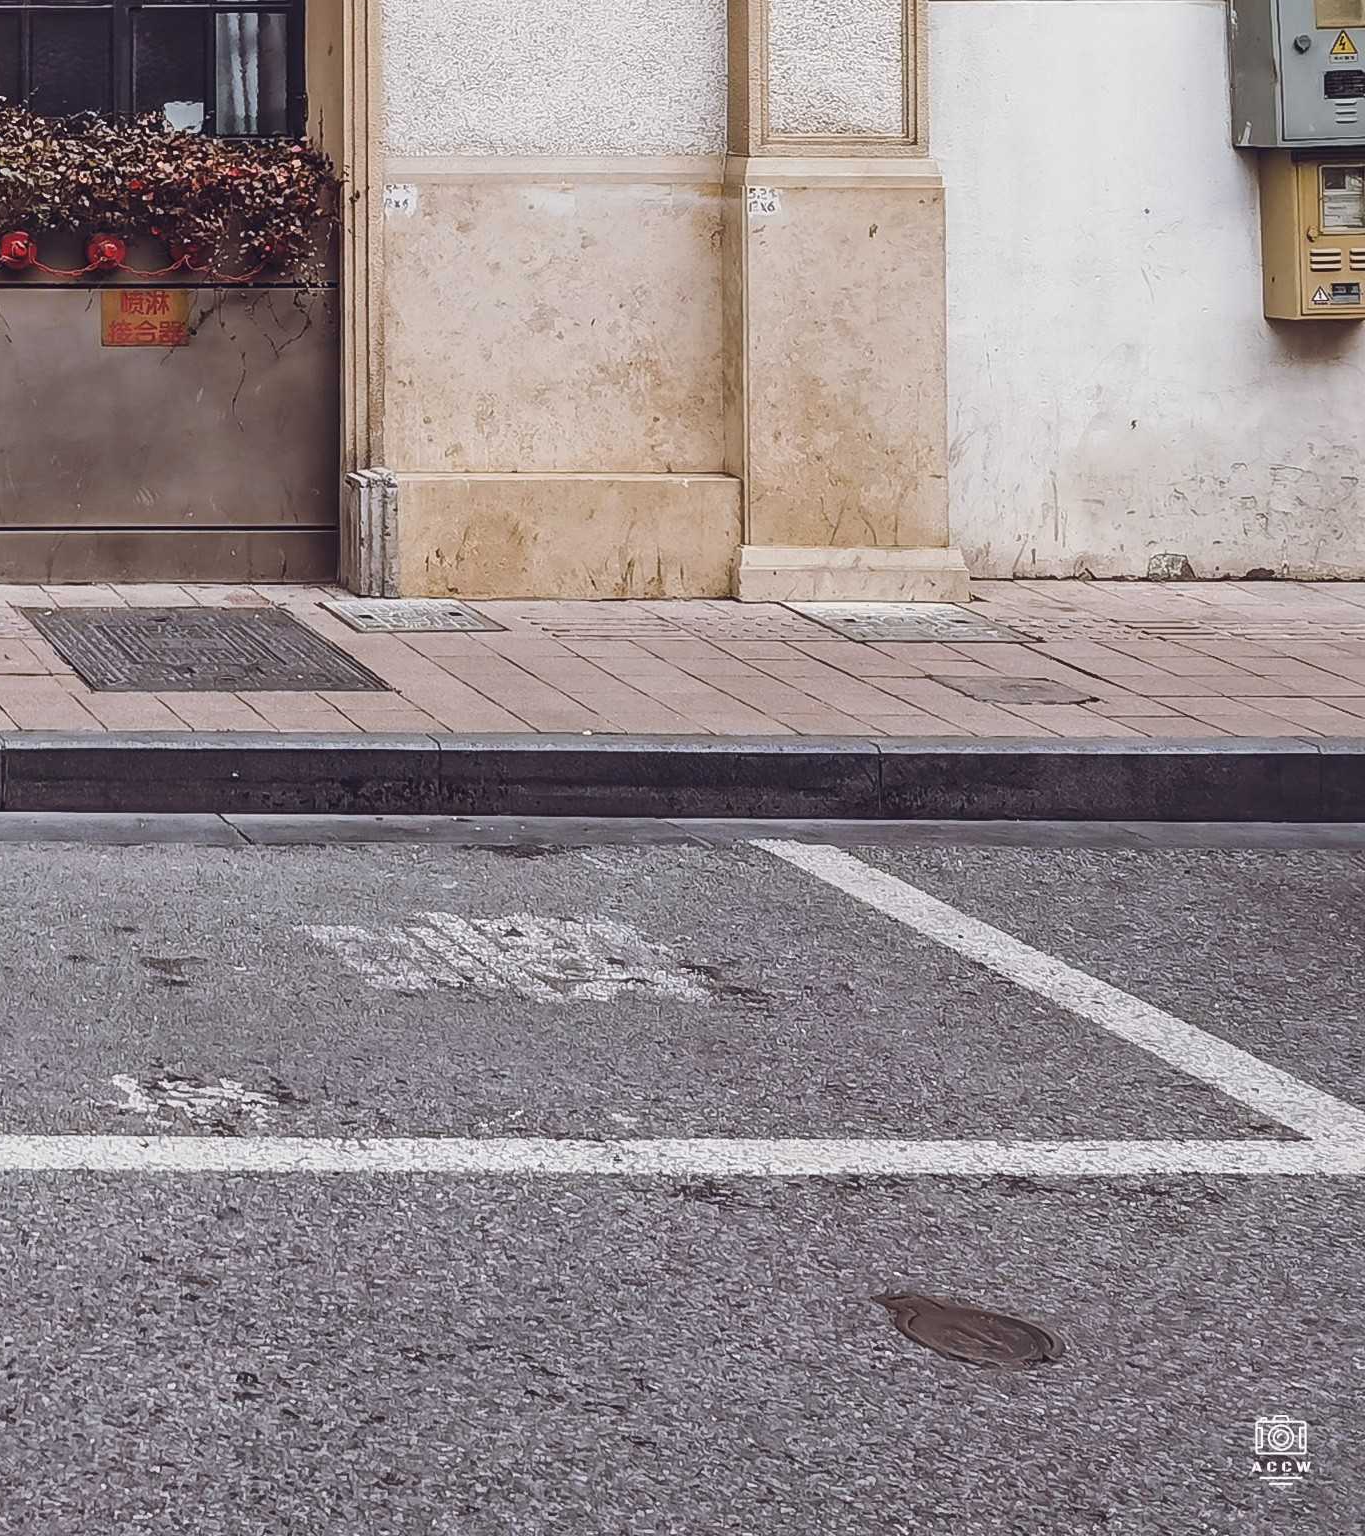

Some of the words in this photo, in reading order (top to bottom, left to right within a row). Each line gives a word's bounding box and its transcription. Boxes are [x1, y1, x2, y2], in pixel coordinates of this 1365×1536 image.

[120, 290, 171, 315] 喷淋
[108, 319, 186, 345] 接合器
